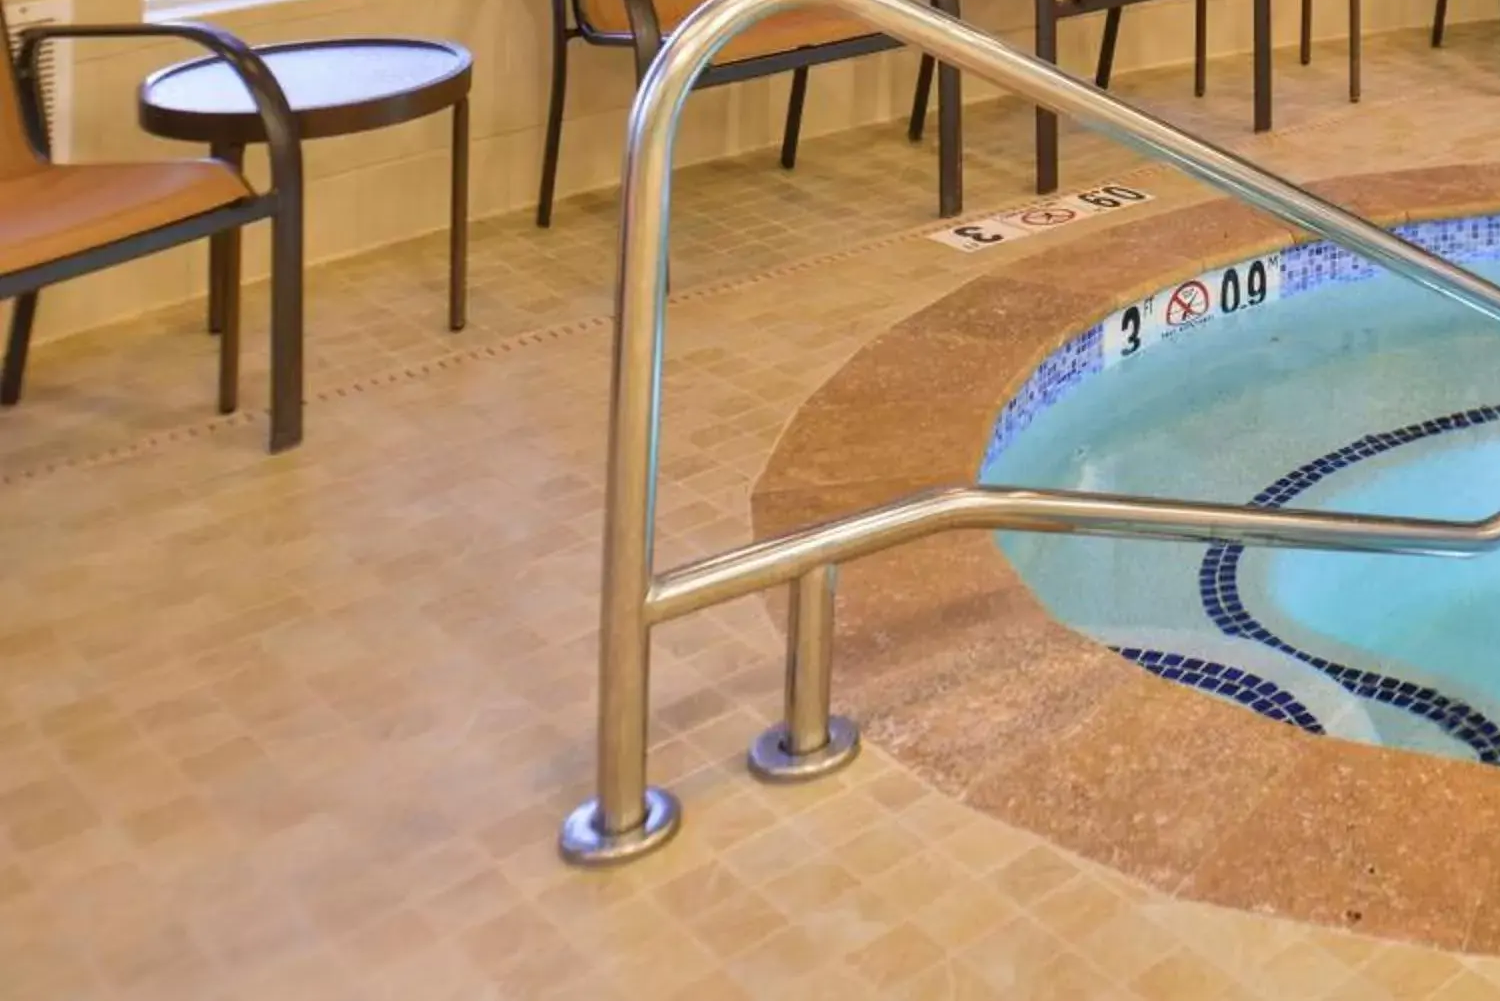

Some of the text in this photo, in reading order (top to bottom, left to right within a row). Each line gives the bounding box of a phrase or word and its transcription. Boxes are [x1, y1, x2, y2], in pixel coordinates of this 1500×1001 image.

[954, 225, 1004, 243] 3
[1220, 255, 1279, 313] 0.9 M
[1120, 297, 1155, 356] 3 FT
